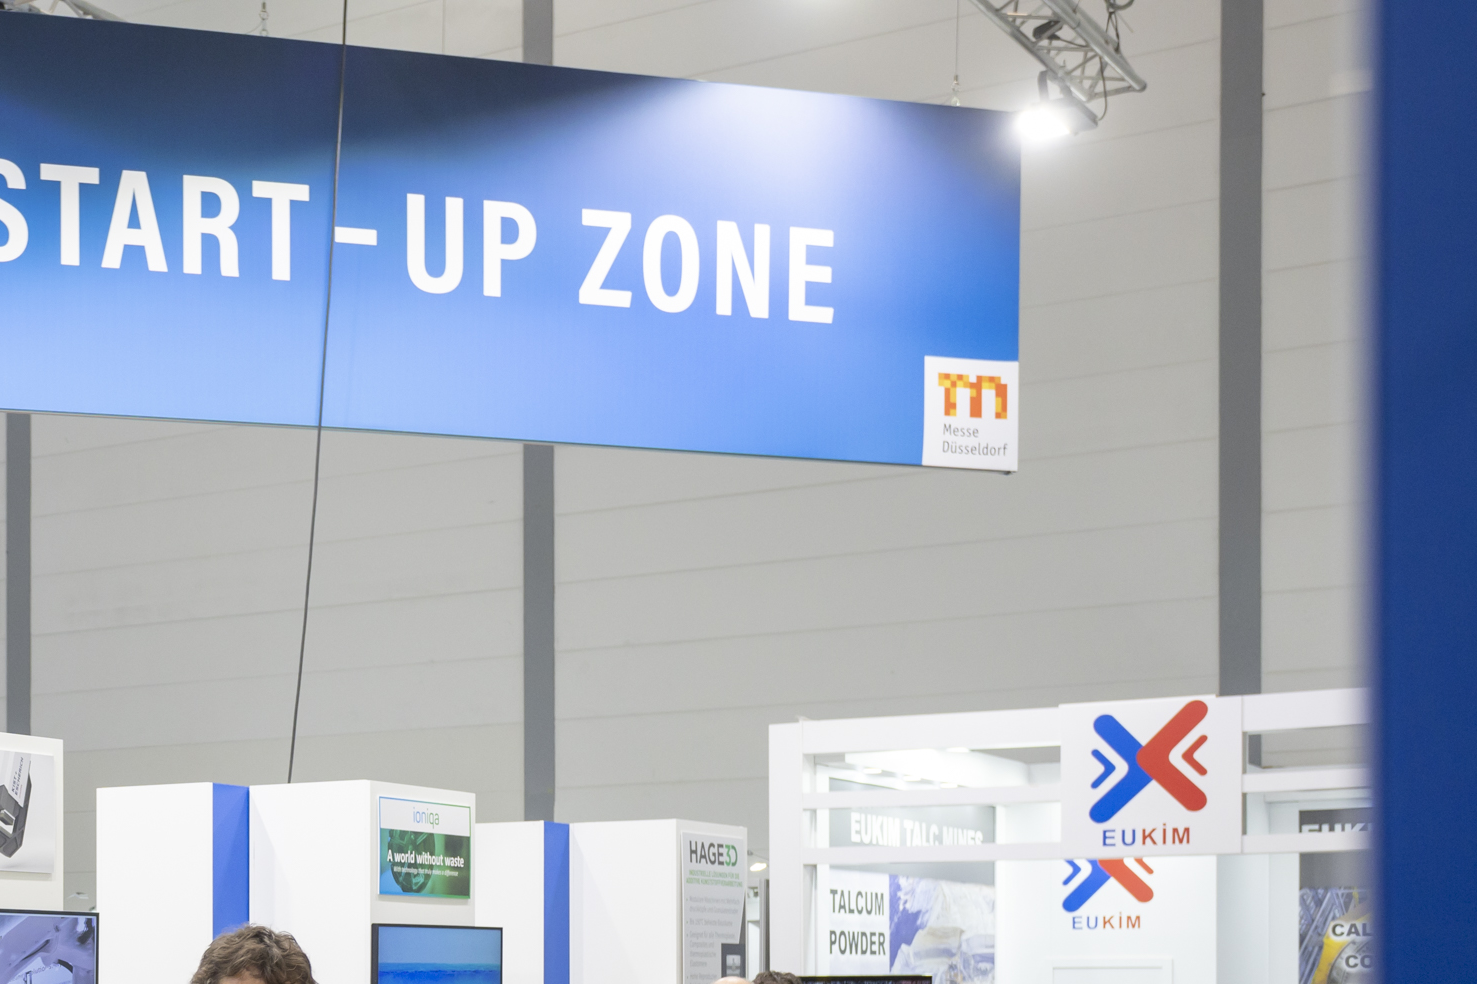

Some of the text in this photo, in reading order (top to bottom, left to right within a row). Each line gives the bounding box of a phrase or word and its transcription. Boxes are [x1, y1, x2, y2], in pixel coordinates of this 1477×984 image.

[578, 208, 836, 325] ZONE
[943, 423, 980, 438] Messe
[942, 440, 1008, 457] Düsseldorf
[412, 806, 440, 829] ioniqa
[850, 811, 901, 847] EUKIM
[903, 819, 939, 847] TALC
[386, 849, 465, 868] A world without waste
[689, 840, 738, 867] HAGE3D
[829, 888, 885, 916] TALCUM
[829, 929, 886, 956] POWDER
